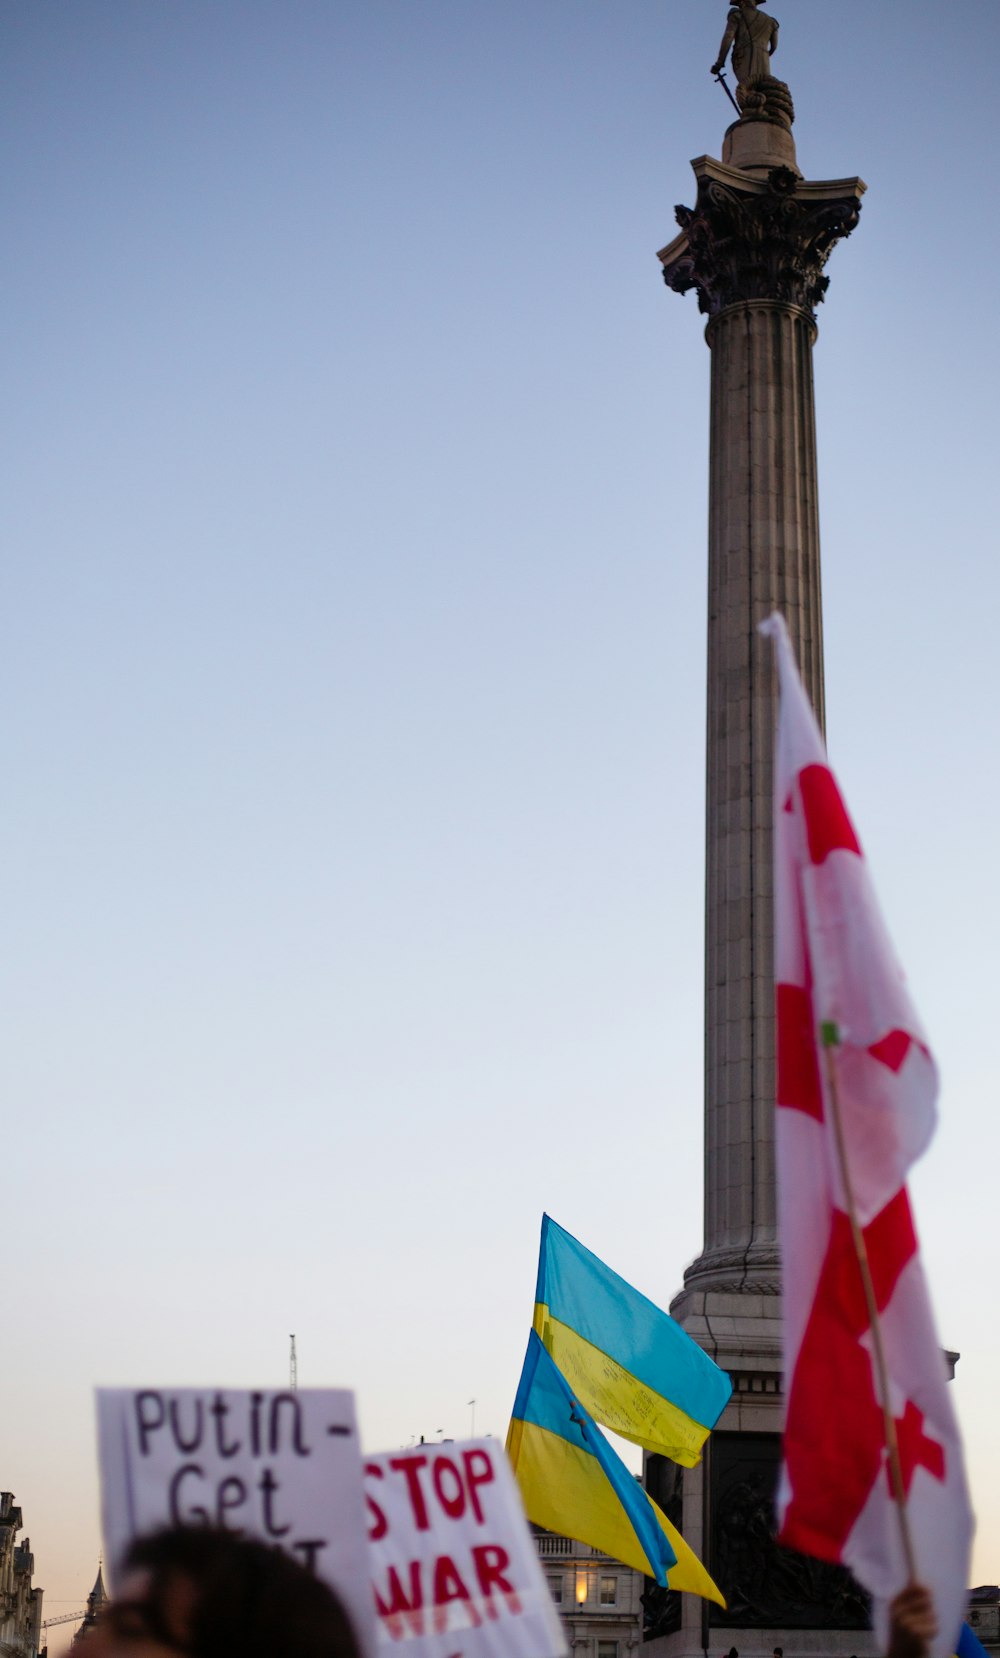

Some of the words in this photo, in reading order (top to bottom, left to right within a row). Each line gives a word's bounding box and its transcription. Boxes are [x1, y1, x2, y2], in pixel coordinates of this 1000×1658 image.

[170, 1463, 291, 1538] Get
[364, 1448, 496, 1543] STOP
[371, 1544, 523, 1643] WAR
